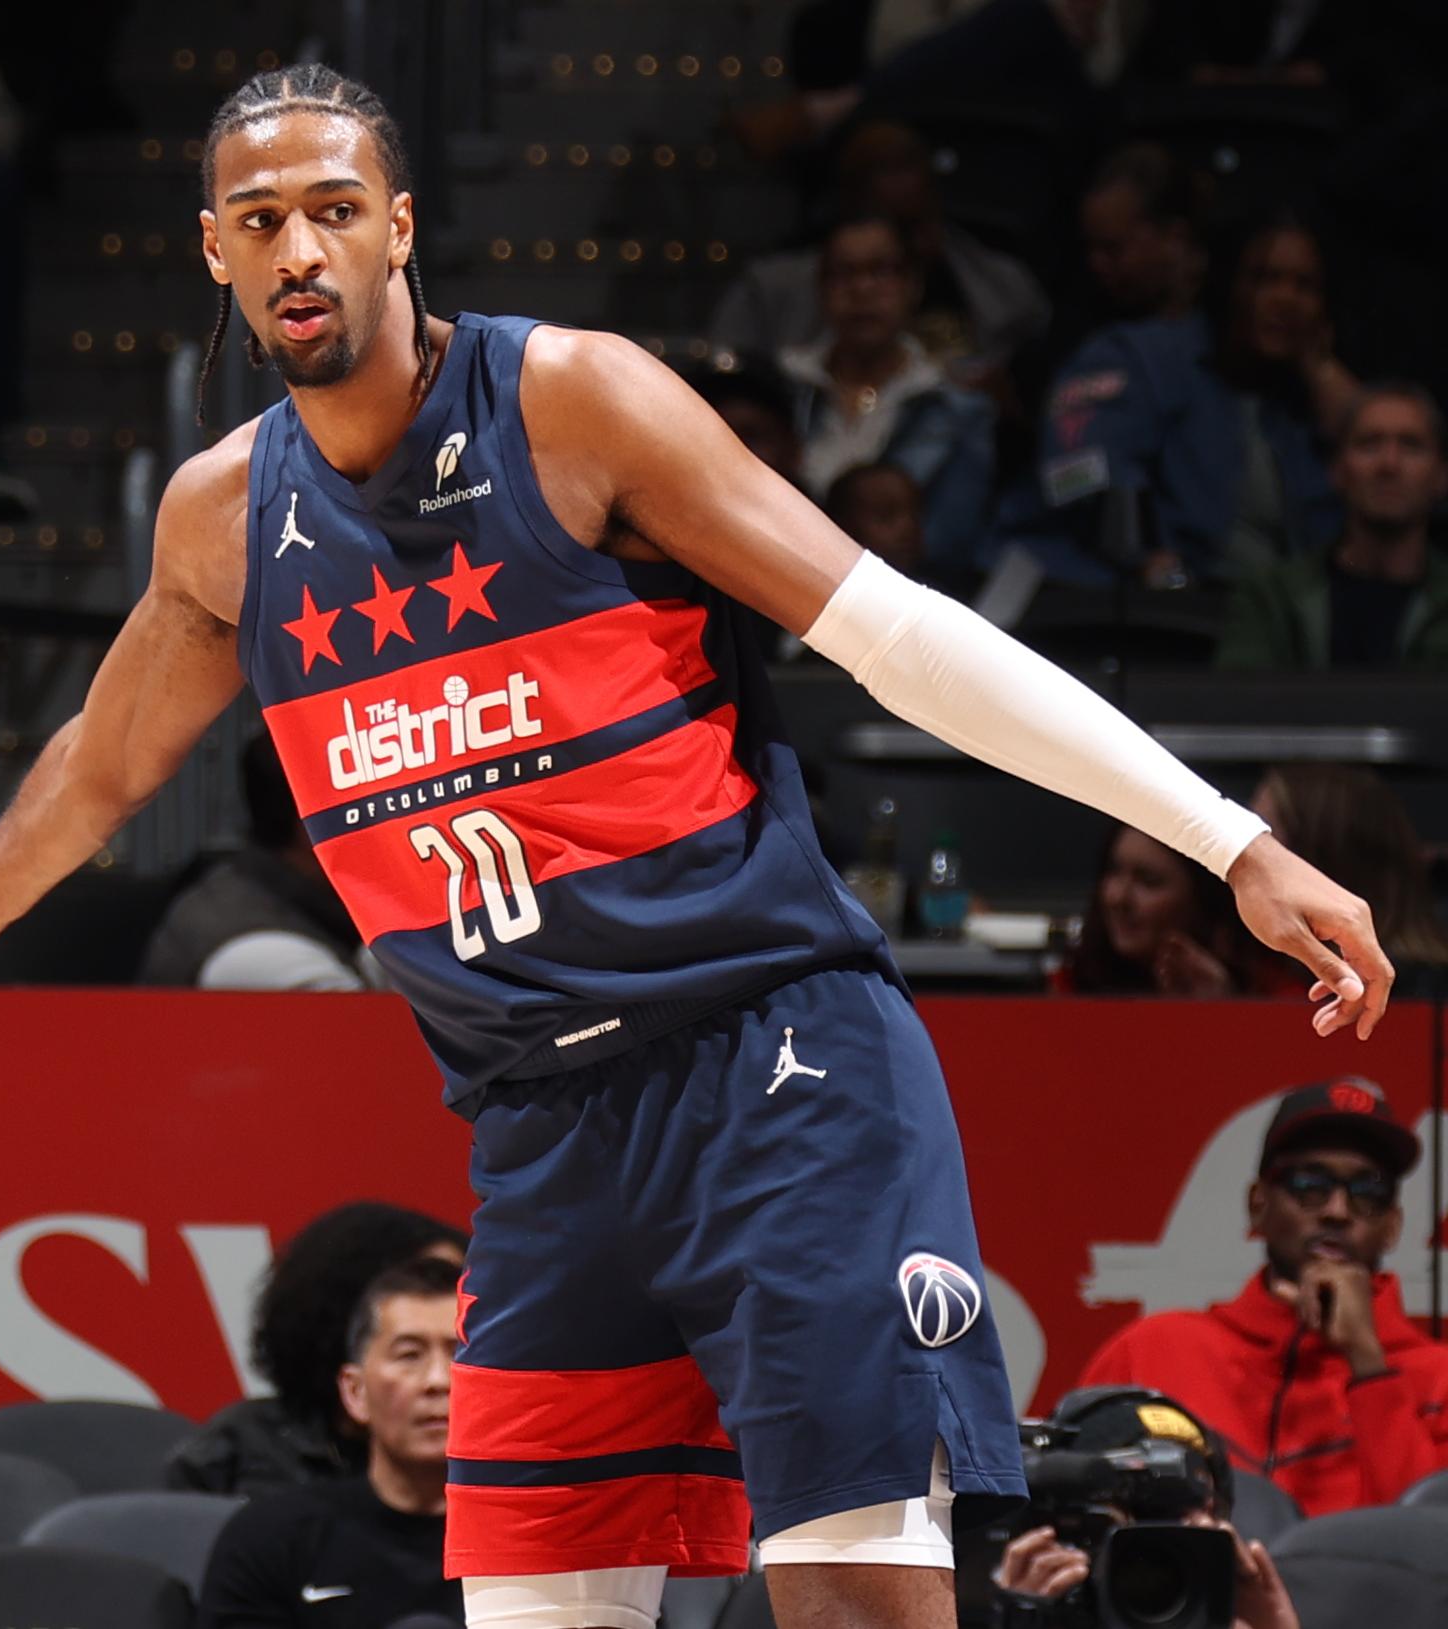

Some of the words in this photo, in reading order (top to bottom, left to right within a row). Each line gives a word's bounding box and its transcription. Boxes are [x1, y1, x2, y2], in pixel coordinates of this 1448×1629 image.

[419, 478, 492, 514] Robinhood
[365, 698, 397, 724] THE
[327, 672, 543, 790] district
[409, 807, 543, 962] 20
[555, 1018, 621, 1047] WASHINGTON
